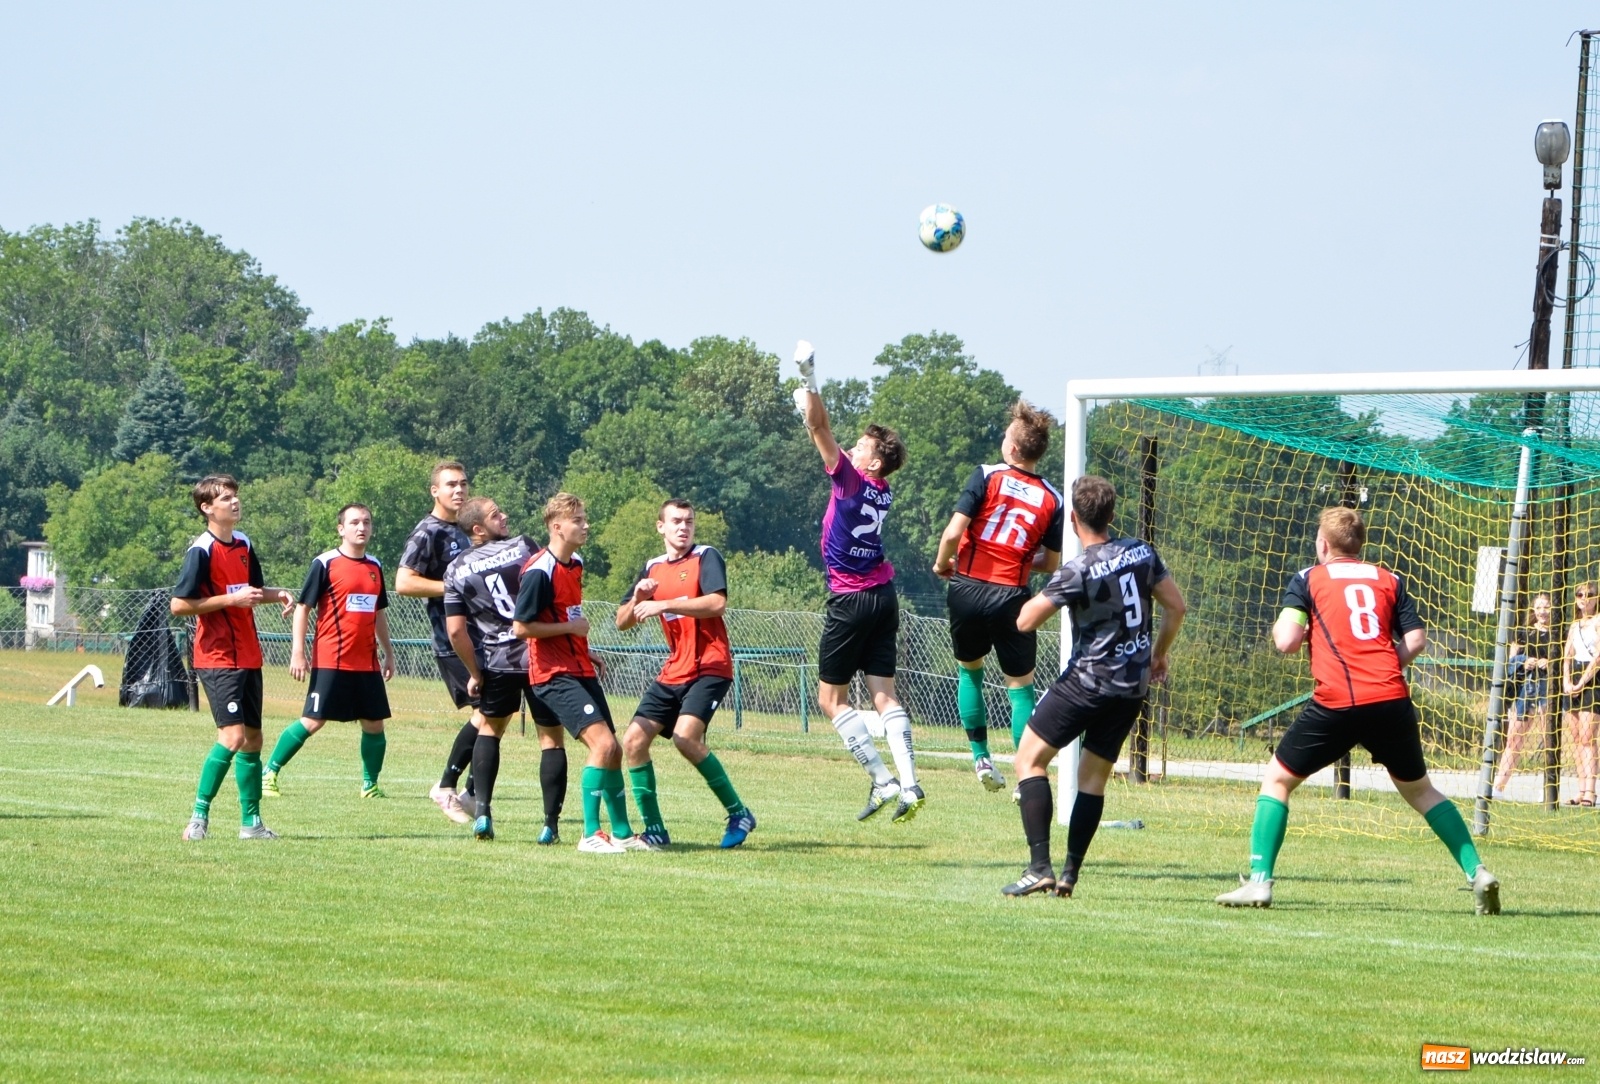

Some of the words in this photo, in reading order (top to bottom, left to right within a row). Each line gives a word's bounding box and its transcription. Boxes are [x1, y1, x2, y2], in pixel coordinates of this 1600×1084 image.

[863, 486, 878, 500] KS
[980, 503, 1037, 550] 16
[1089, 560, 1110, 580] LKS
[484, 572, 516, 620] 8
[1118, 571, 1143, 628] 9
[1343, 583, 1381, 641] 8
